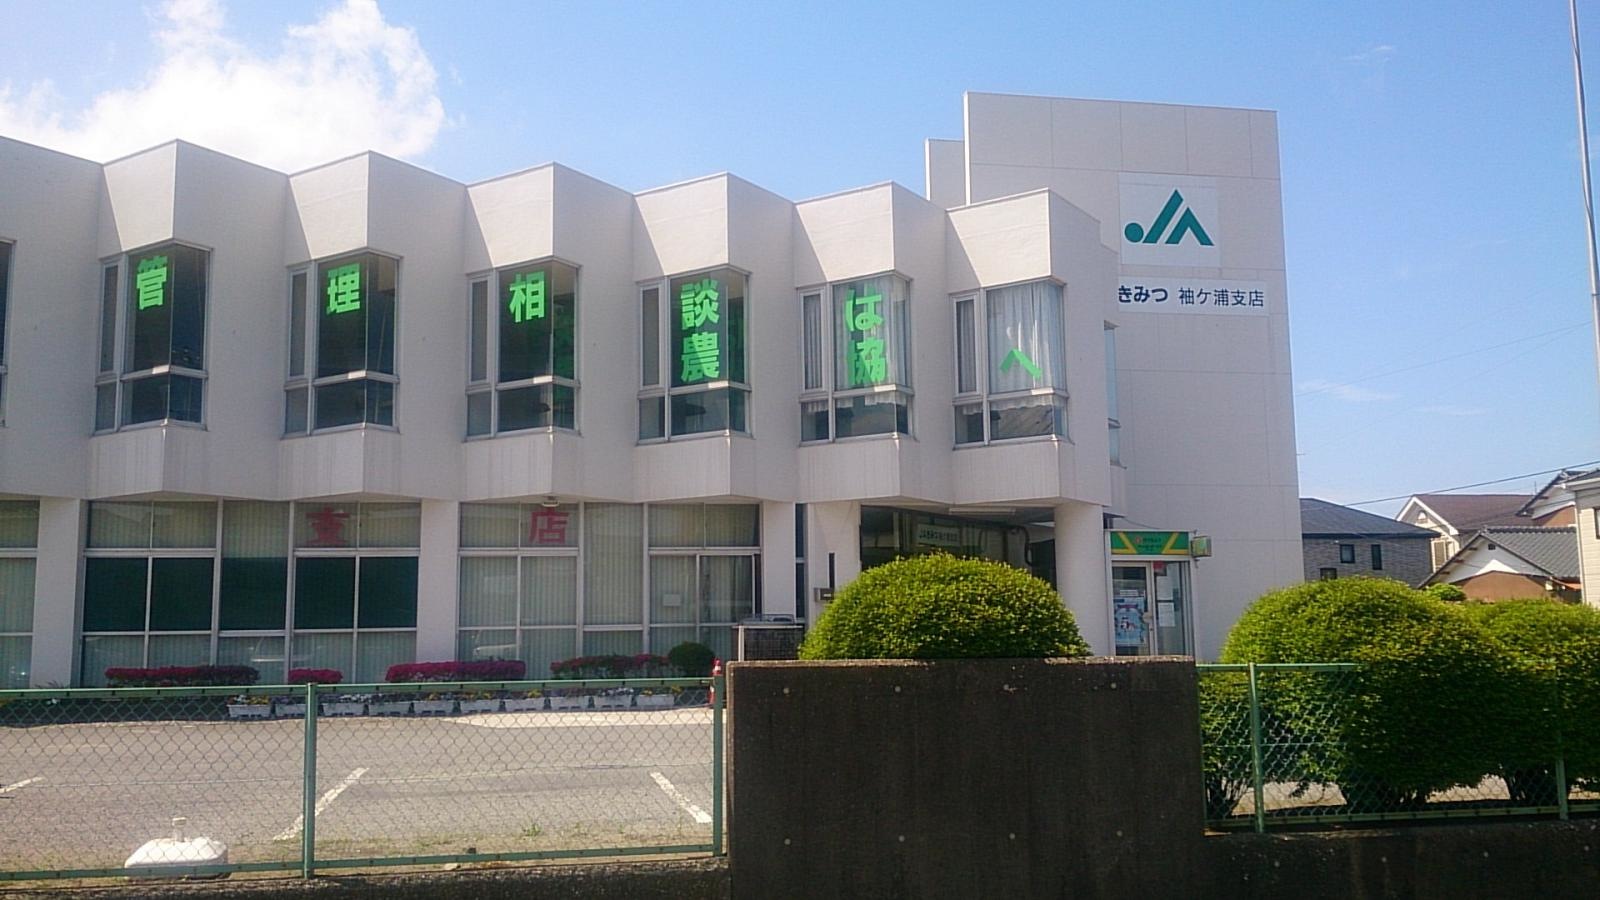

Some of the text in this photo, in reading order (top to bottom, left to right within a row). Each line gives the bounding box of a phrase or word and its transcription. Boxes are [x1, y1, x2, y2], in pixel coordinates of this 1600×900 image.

[136, 255, 167, 310] 管
[326, 263, 361, 315] 理
[509, 270, 547, 322] 相
[1118, 285, 1265, 307] きみつ 袖ケ浦支店
[528, 506, 569, 544] 店
